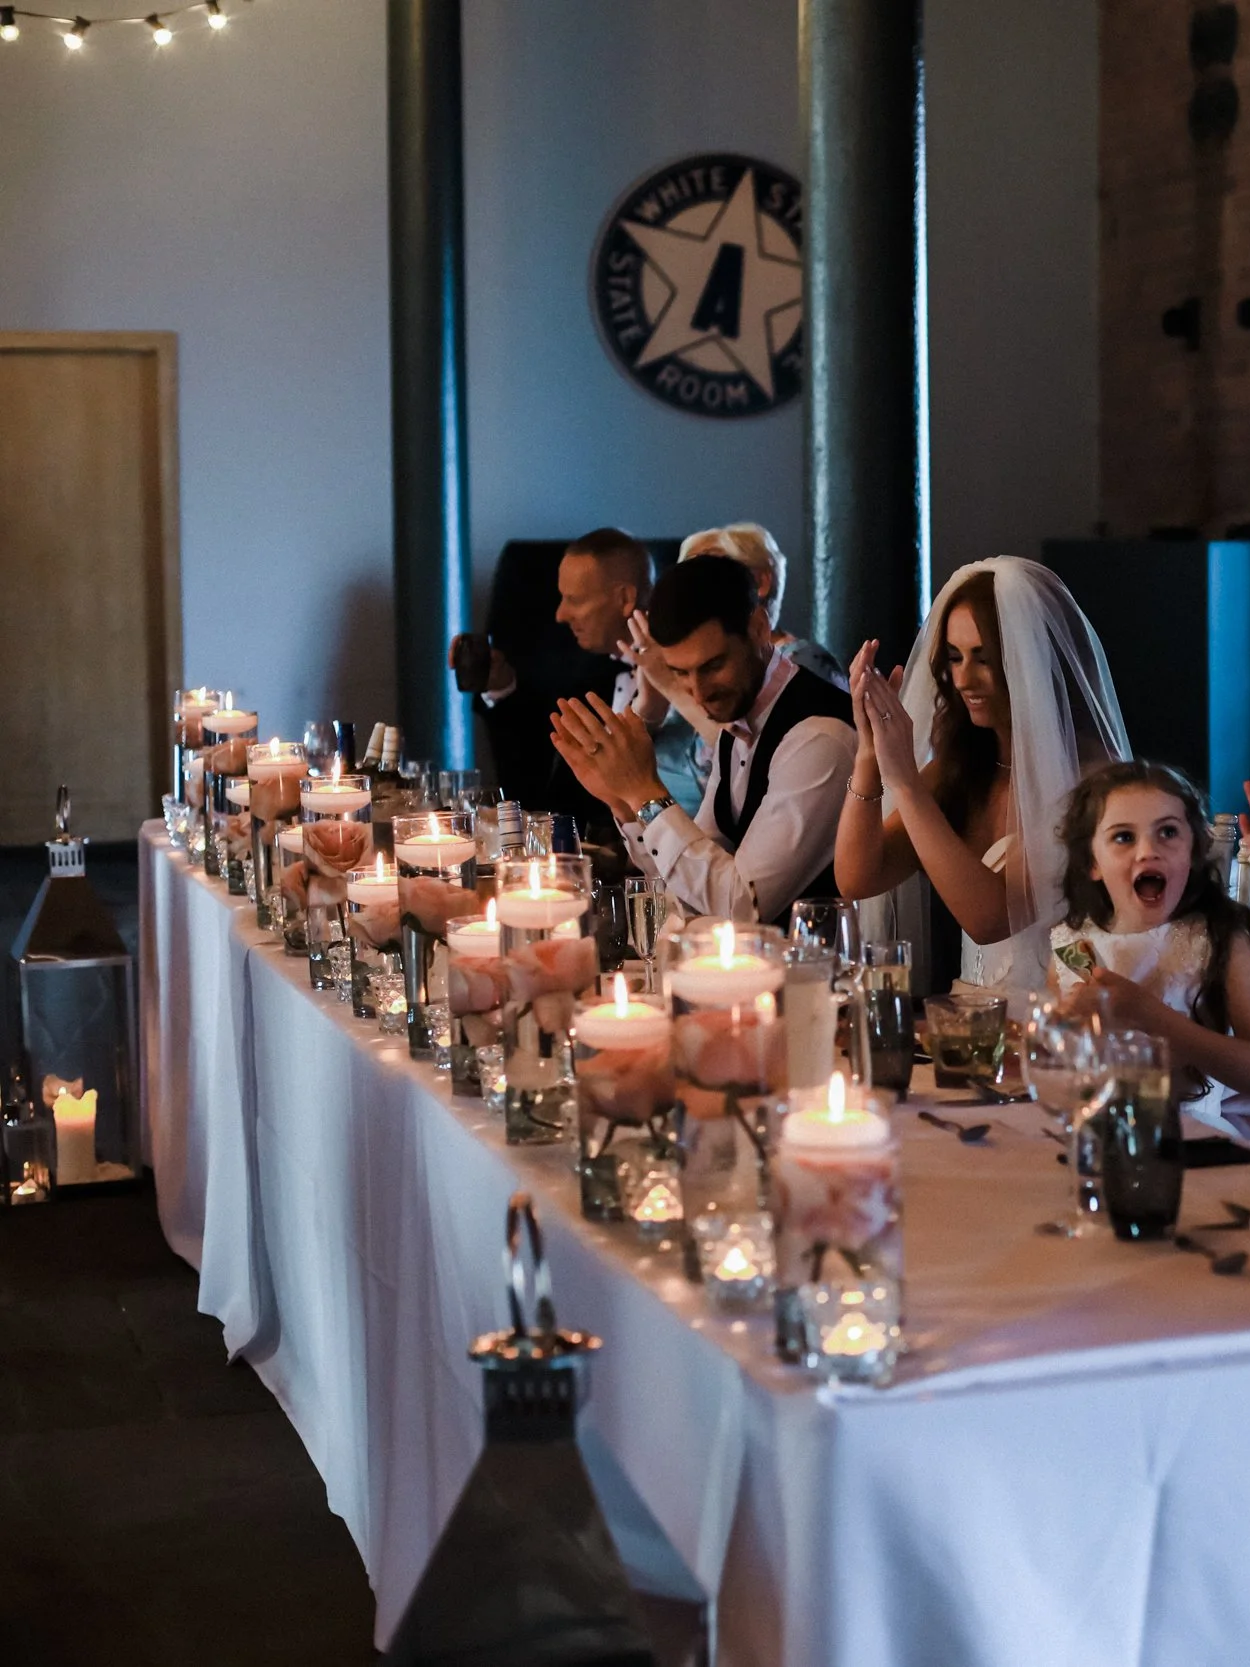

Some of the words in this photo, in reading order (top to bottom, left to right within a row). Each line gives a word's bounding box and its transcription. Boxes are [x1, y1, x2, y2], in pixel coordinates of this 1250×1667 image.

[635, 166, 728, 221] WHITE
[608, 250, 645, 345] STATE
[655, 365, 748, 407] ROOM
